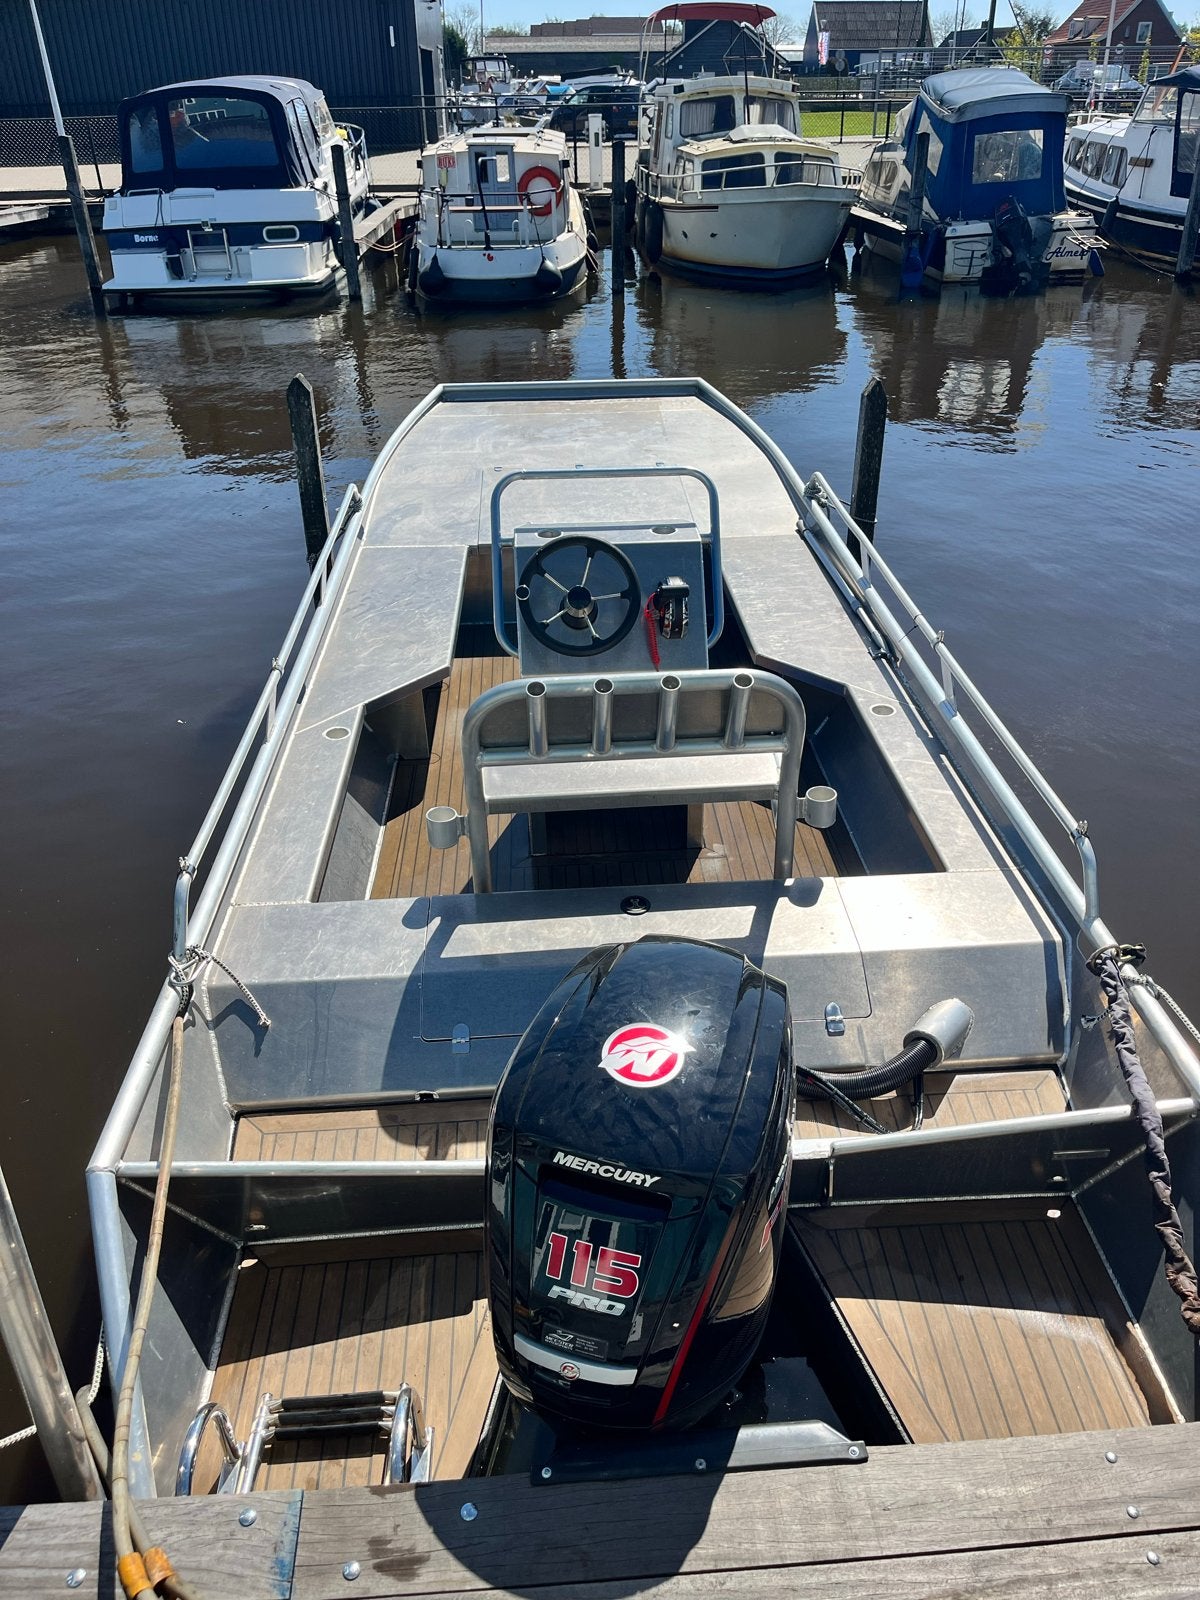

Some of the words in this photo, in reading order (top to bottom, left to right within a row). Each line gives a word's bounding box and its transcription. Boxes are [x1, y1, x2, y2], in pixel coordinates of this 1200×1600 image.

[133, 234, 159, 243] Borne
[552, 1151, 662, 1188] MERCURY
[545, 1231, 642, 1299] 115
[547, 1285, 626, 1316] PRO
